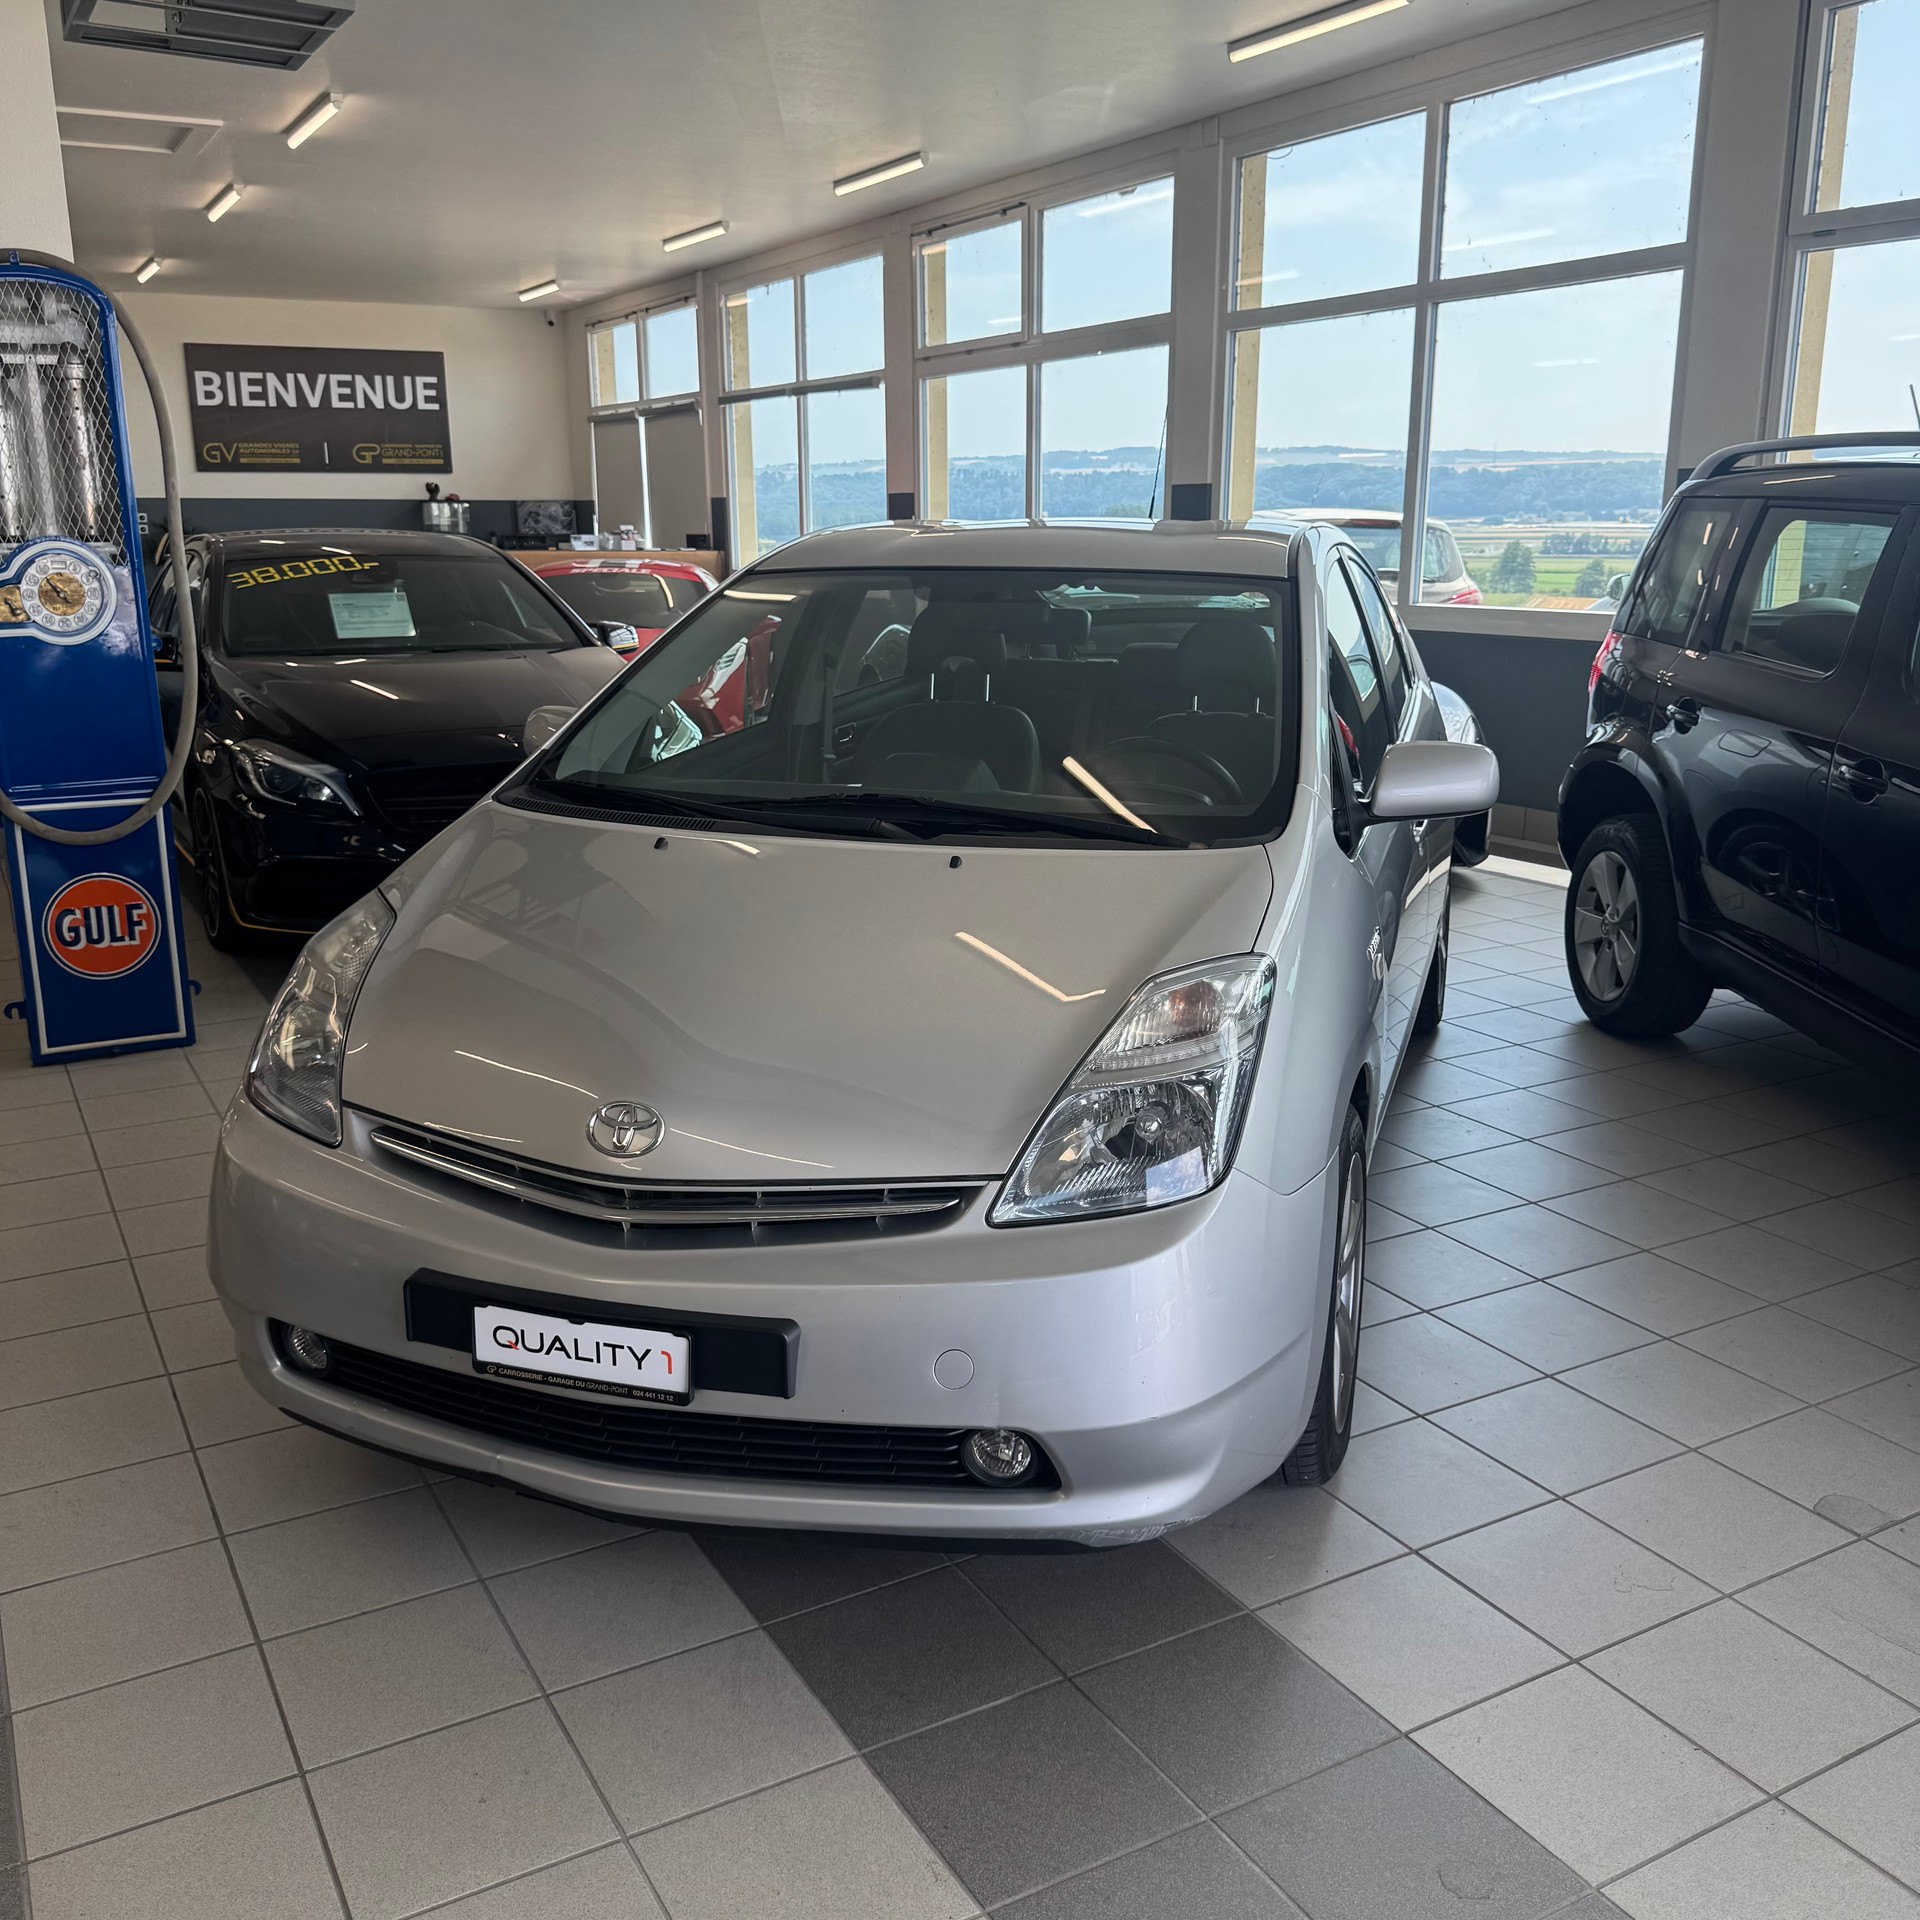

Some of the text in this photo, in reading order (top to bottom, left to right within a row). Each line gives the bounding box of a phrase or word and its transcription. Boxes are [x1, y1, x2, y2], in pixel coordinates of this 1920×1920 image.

[194, 370, 440, 411] BIENVENUE
[203, 442, 238, 463] GV
[54, 901, 148, 951] GULF
[492, 1325, 673, 1375] QUALITY 1
[498, 1367, 543, 1381] CARROSSERIE
[547, 1375, 574, 1386] GARAGE
[575, 1380, 585, 1388] DU
[585, 1382, 628, 1395] GRAND-PONT
[632, 1389, 644, 1397] 024
[644, 1391, 656, 1399] 441
